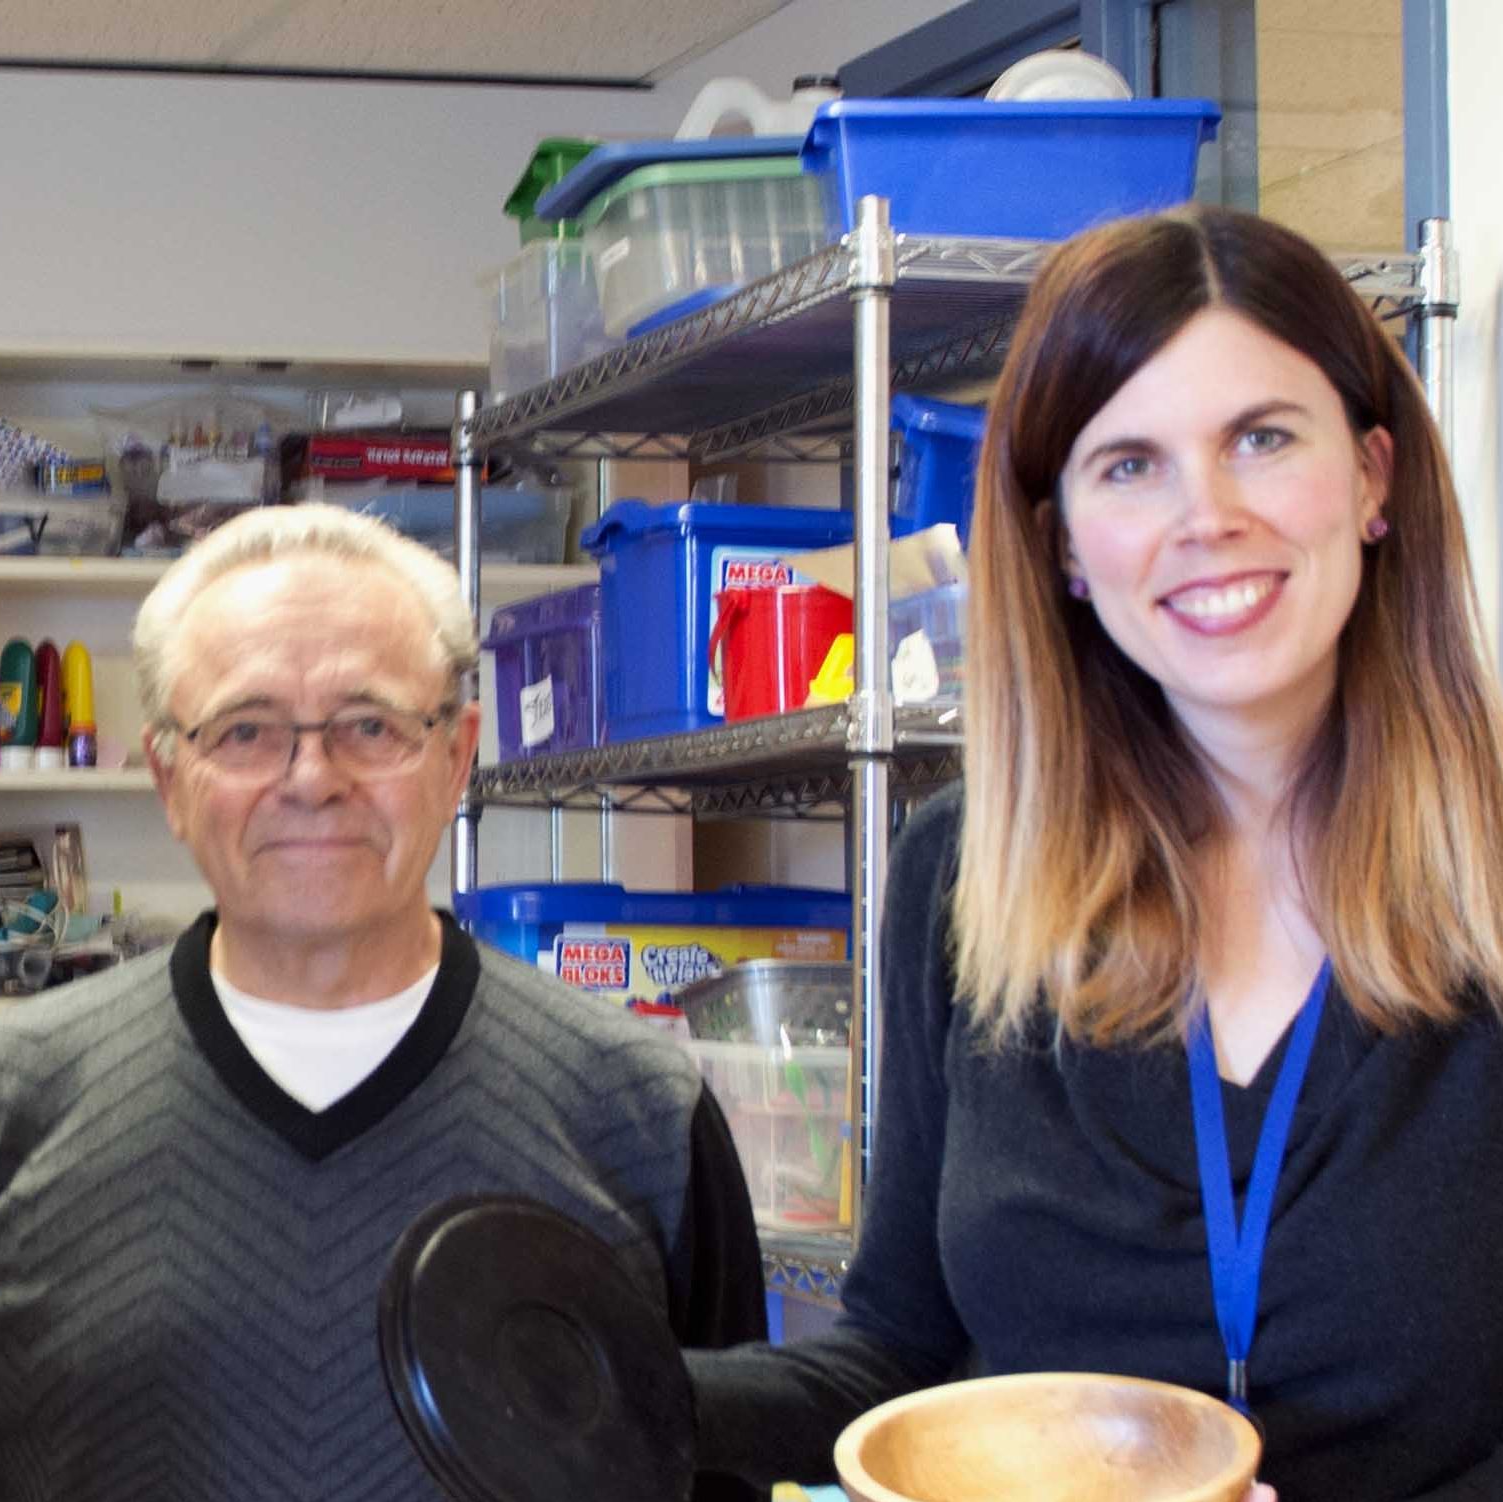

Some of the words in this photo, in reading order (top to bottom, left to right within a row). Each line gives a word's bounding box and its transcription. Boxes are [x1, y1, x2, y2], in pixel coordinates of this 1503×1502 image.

[727, 561, 790, 584] MEGA
[563, 943, 626, 963] MEGA
[562, 966, 626, 985] BLOKS
